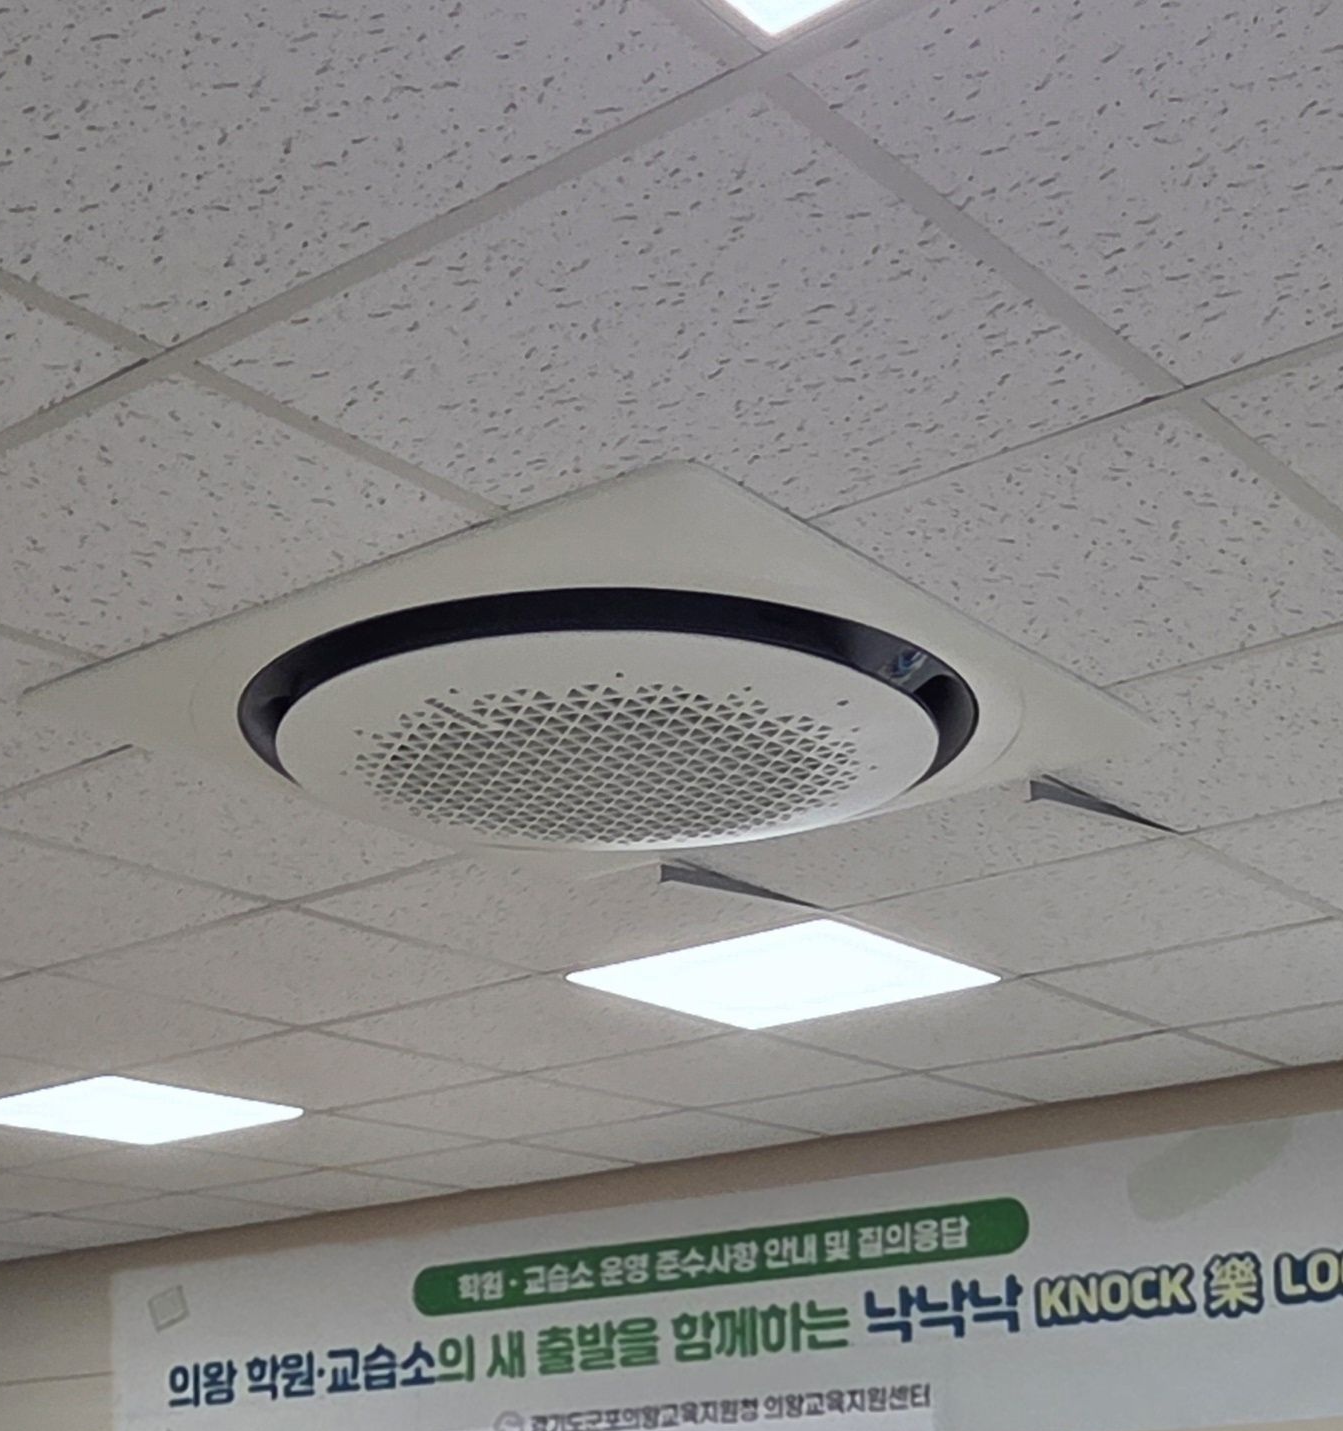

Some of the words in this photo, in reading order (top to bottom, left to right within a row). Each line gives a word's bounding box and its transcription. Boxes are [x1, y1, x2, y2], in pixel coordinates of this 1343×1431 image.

[458, 1269, 504, 1301] 학원
[523, 1260, 596, 1296] 교습소
[600, 1253, 649, 1287] 운영
[654, 1240, 759, 1282] 준수사항
[764, 1228, 817, 1270] 안내
[825, 1229, 851, 1262] 및
[858, 1215, 970, 1260] 질의응답
[167, 1359, 237, 1408] 의왕
[245, 1335, 475, 1401] 학원·교습소의
[487, 1329, 526, 1379] 새
[536, 1316, 660, 1376] 출발을
[671, 1298, 851, 1363] 함께하는
[865, 1274, 1023, 1342] 낙낙낙
[1034, 1263, 1196, 1328] KNOCK
[1202, 1252, 1263, 1318] 樂
[764, 1384, 931, 1421] 의왕교육지원센터
